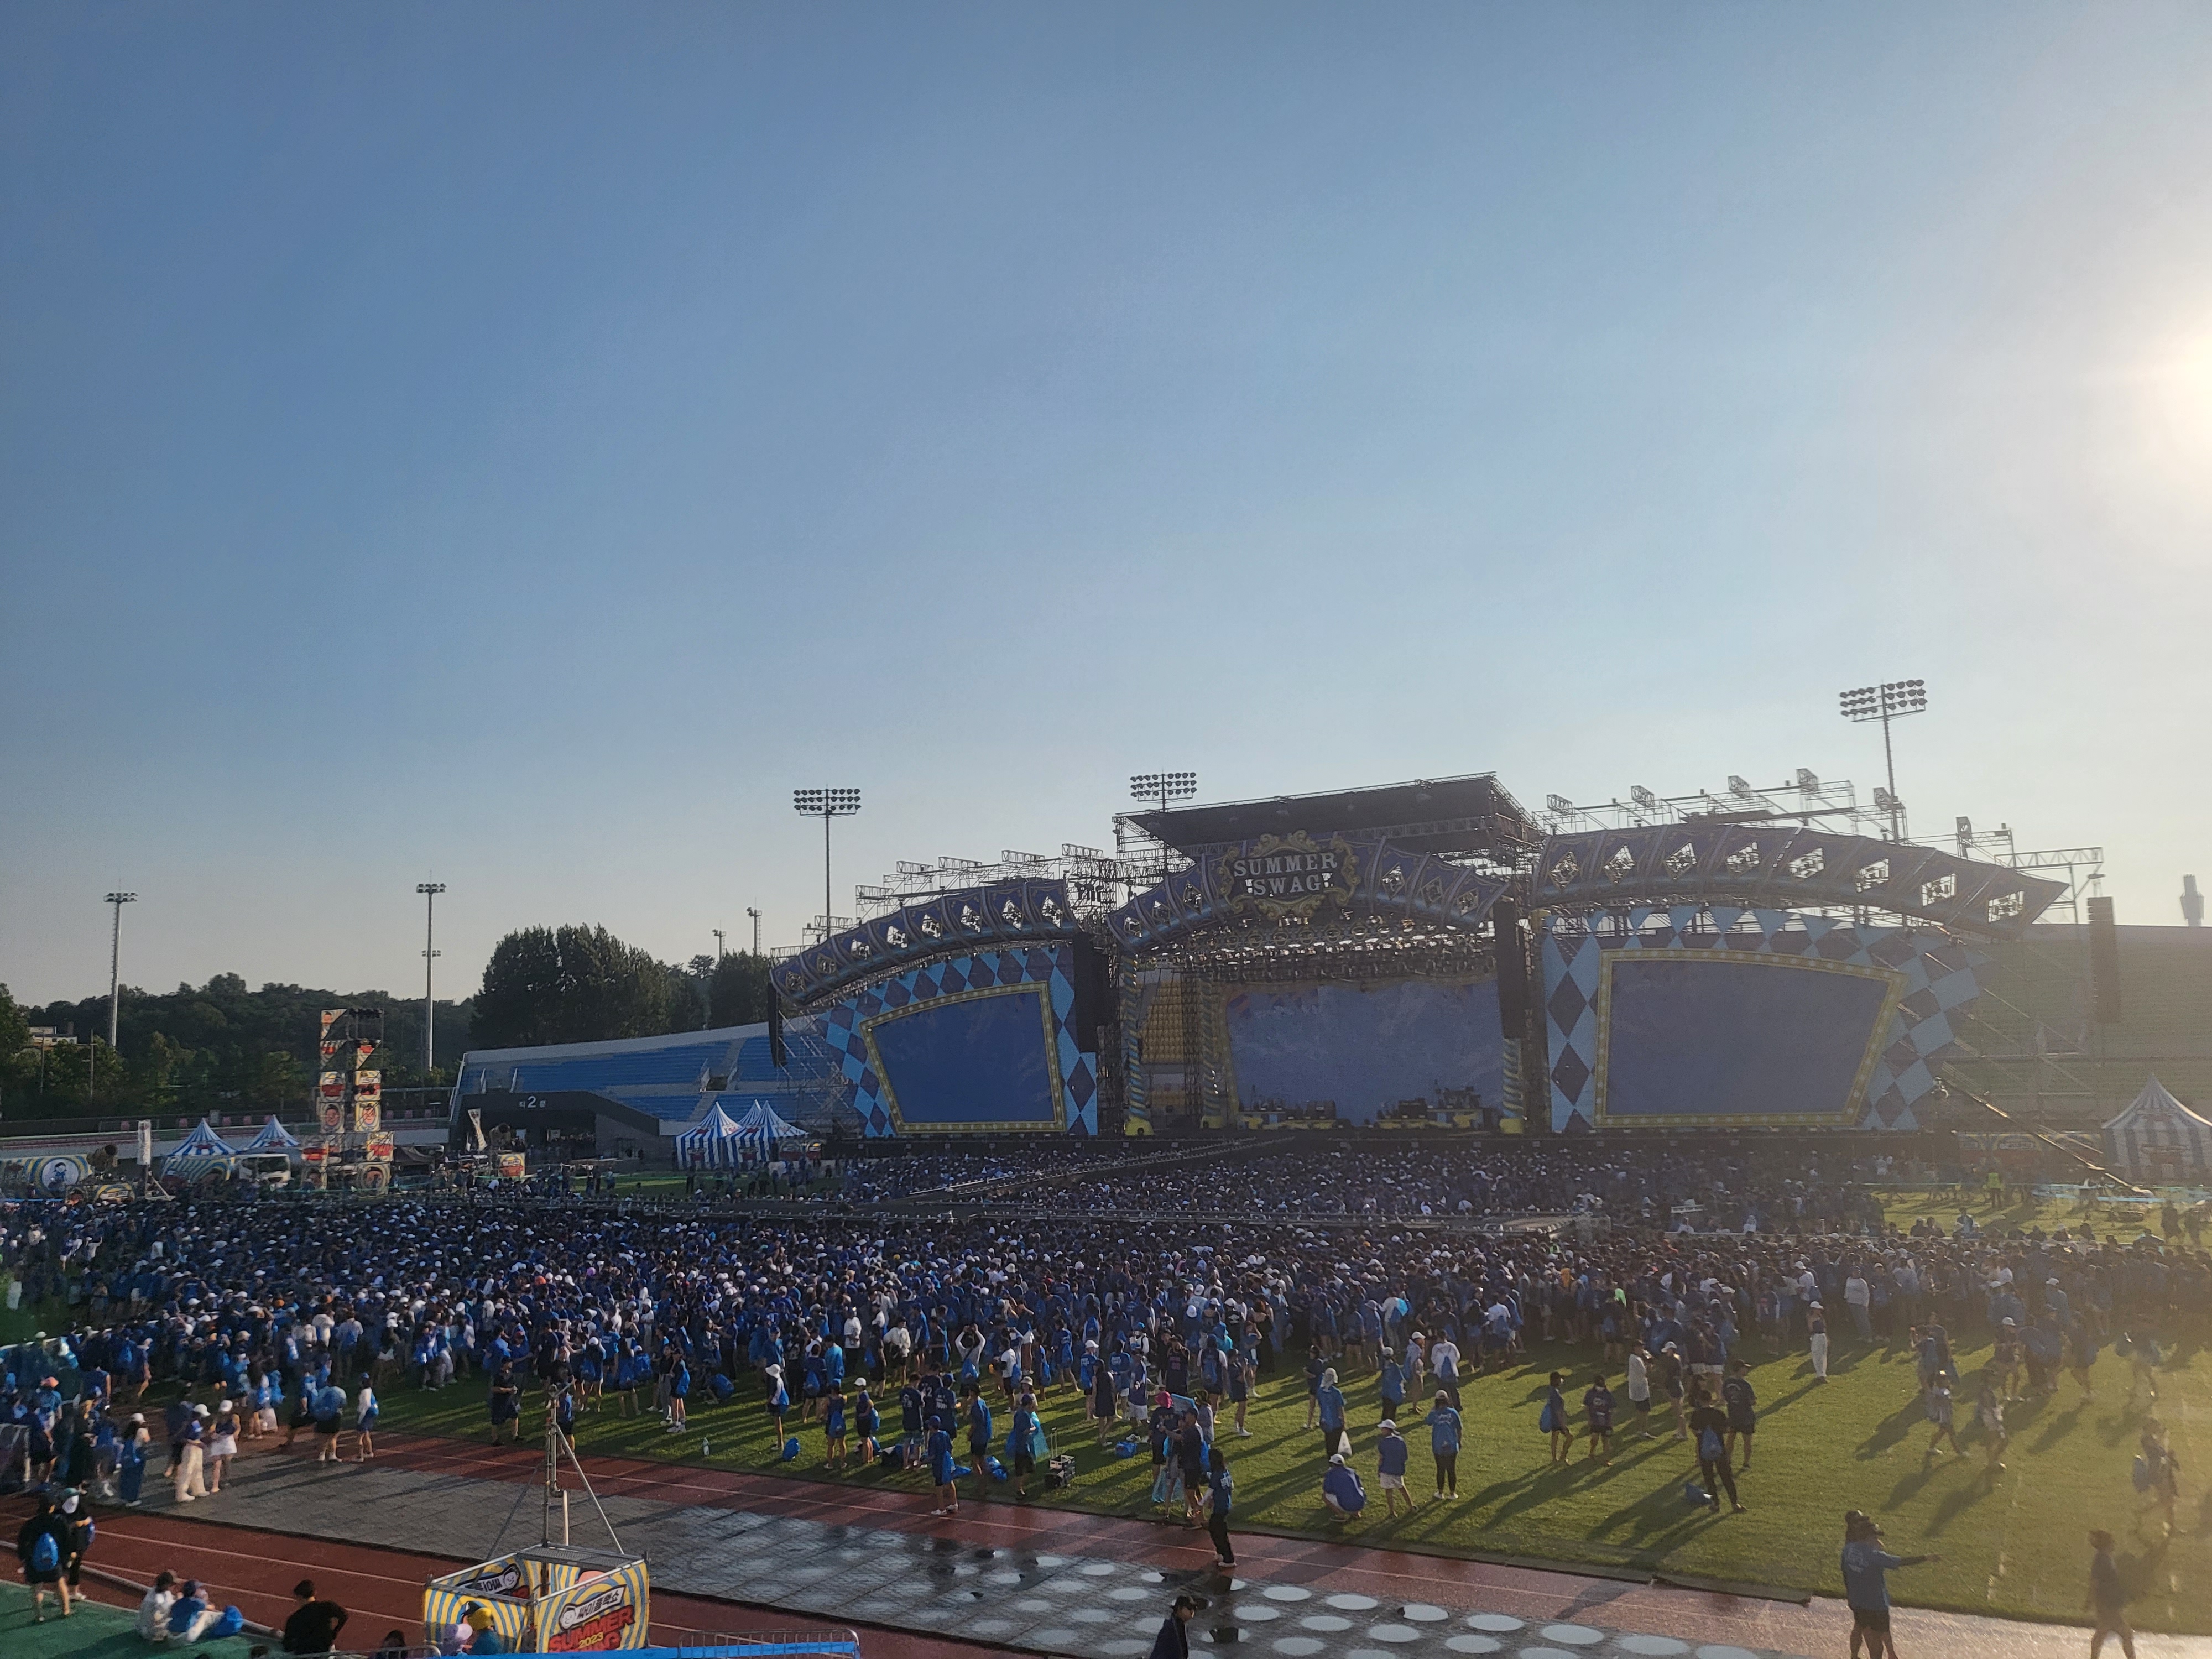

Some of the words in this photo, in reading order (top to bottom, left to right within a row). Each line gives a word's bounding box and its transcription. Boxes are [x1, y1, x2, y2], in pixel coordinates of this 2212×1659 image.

[1234, 852, 1338, 877] SUMMER
[1253, 874, 1321, 895] SWAG
[549, 1605, 635, 1652] SUMMER
[578, 1632, 604, 1649] 2023
